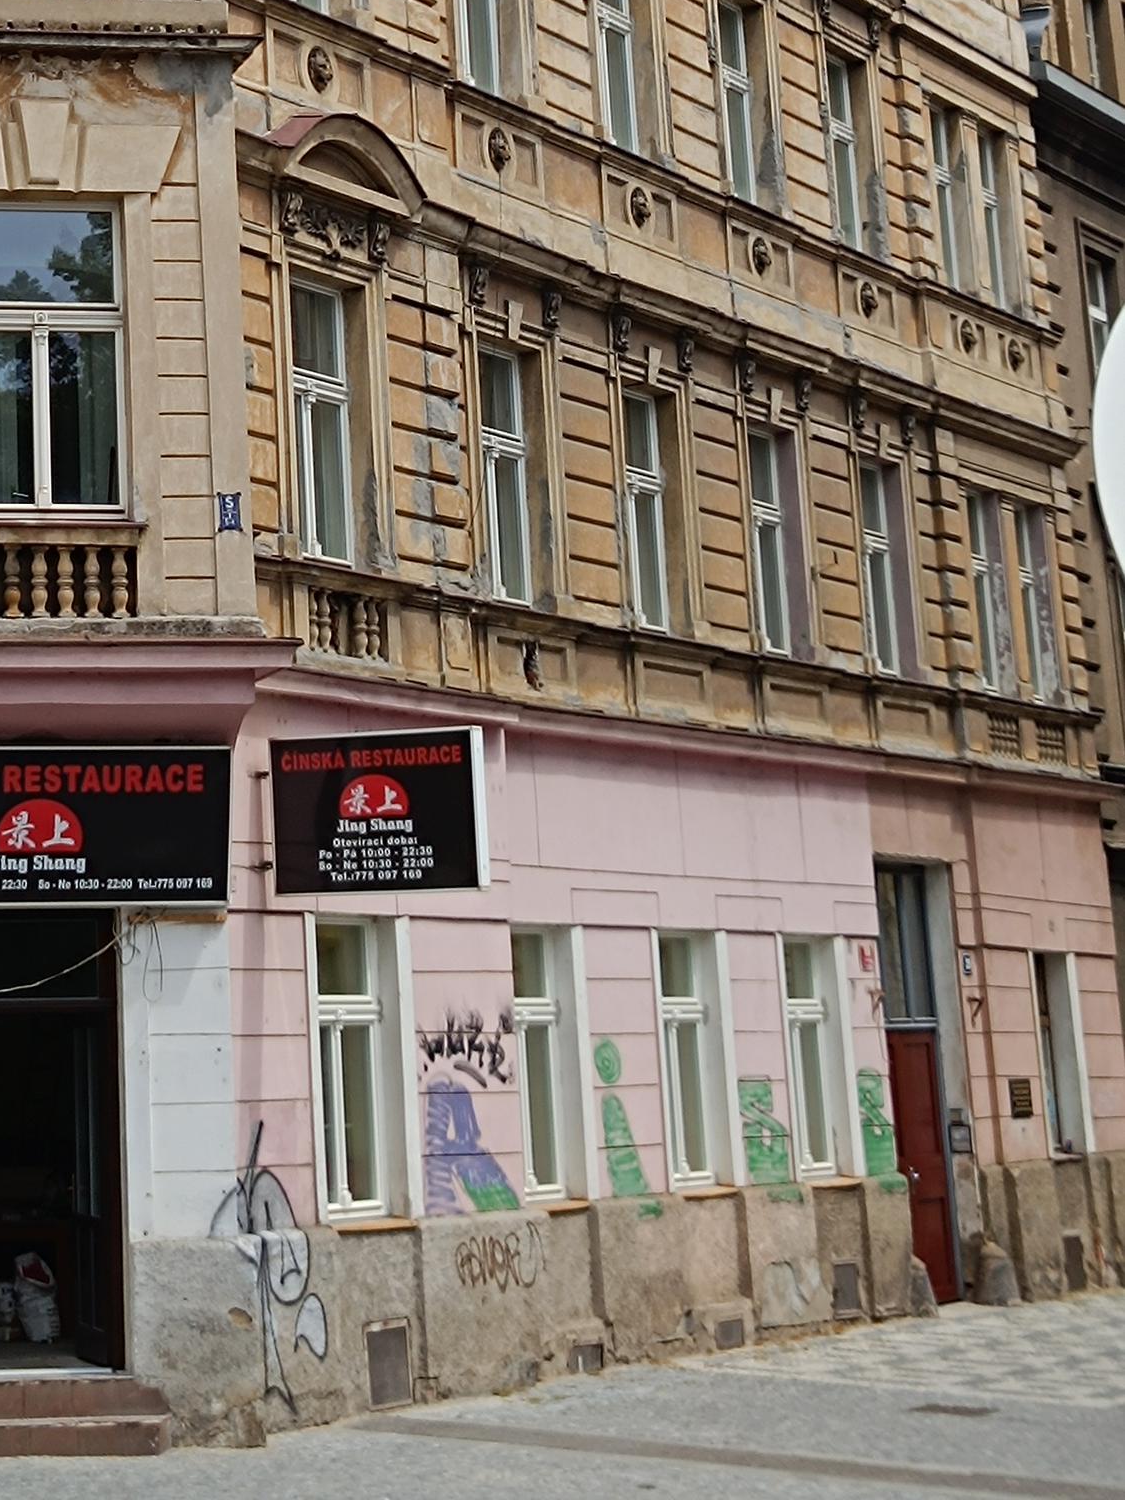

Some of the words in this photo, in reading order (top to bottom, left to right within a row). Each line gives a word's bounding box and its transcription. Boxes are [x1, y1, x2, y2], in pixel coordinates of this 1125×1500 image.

[281, 749, 344, 771] ČÍNSKÁ
[350, 745, 462, 768] RESTAURACE
[2, 763, 204, 794] RESTAURACE
[336, 819, 367, 834] Jing
[370, 818, 413, 833] Shang
[318, 849, 333, 859] Po
[361, 848, 391, 858] 10:00
[402, 846, 433, 856] 22:30
[33, 855, 86, 873] Shang
[318, 860, 333, 871] So
[343, 860, 357, 869] Ne
[362, 859, 392, 869] 10:30
[402, 857, 434, 868] 22:00
[378, 870, 397, 880] 097
[402, 869, 422, 879] 169
[1, 879, 28, 890] 22:30
[38, 879, 50, 889] So
[58, 879, 72, 889] Ne
[74, 879, 99, 889] 10:30
[107, 879, 133, 889] 22:00
[176, 878, 194, 889] 097
[196, 877, 213, 889] 169
